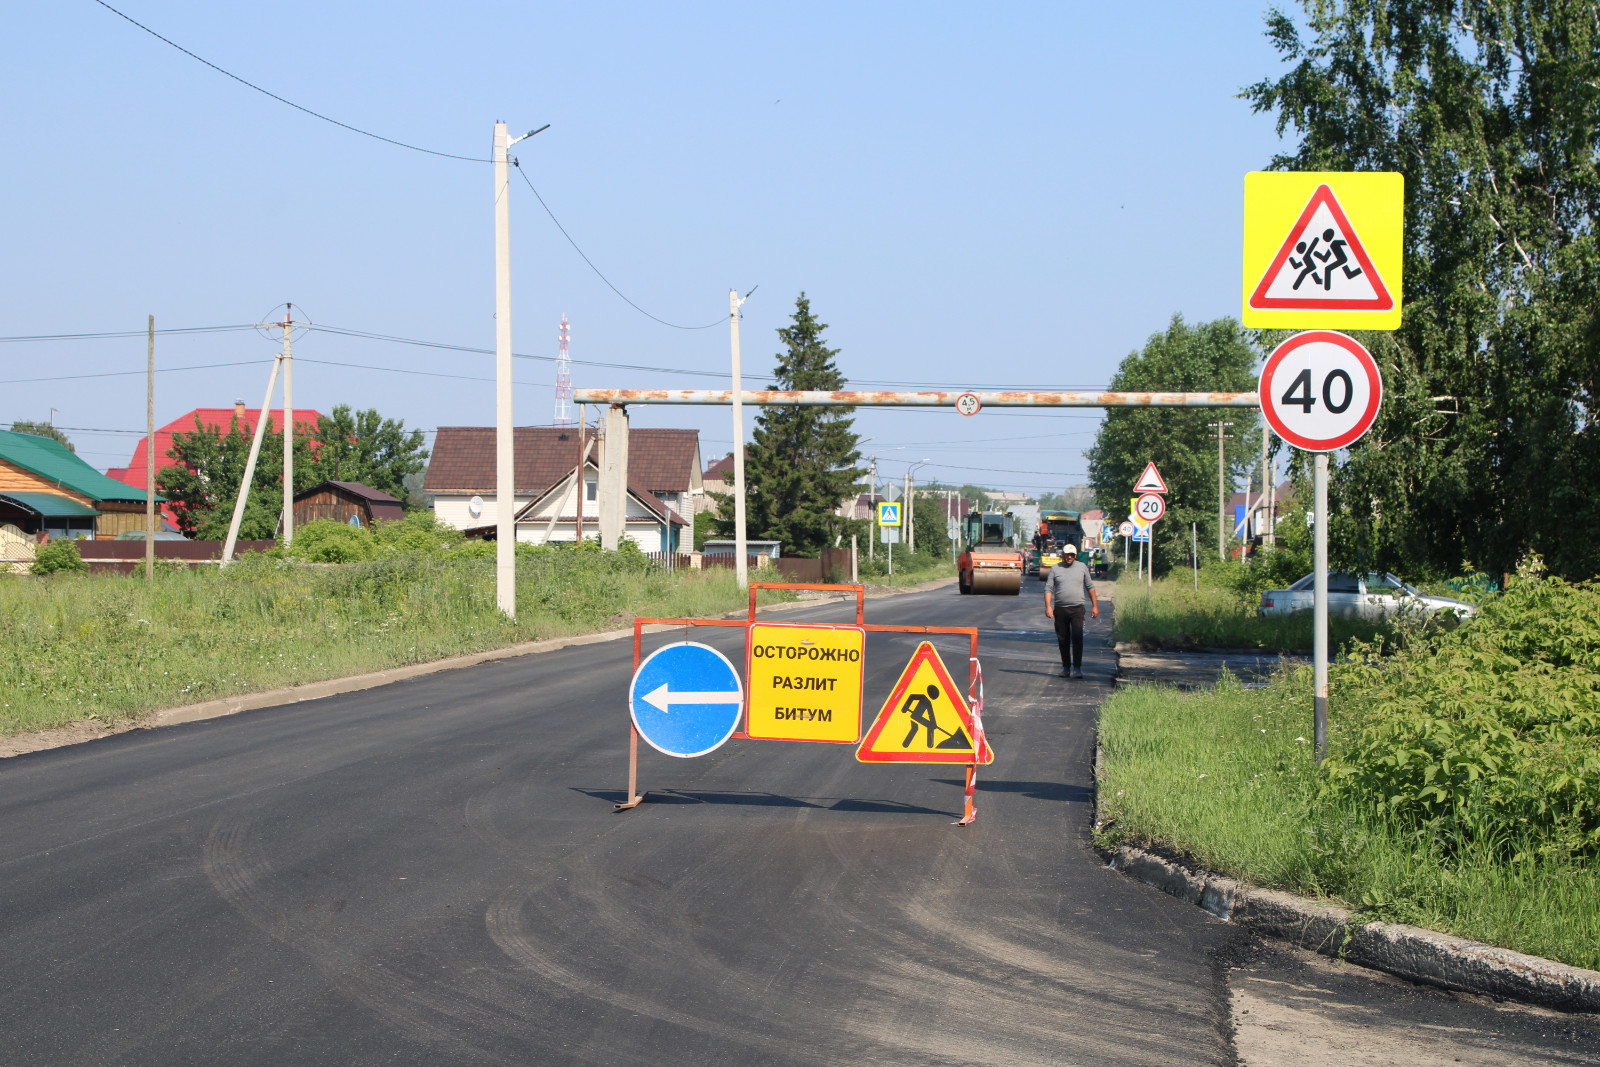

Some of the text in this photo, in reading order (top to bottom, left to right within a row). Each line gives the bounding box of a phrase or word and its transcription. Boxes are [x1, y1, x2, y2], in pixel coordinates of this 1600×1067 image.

[1281, 368, 1354, 414] 40
[1142, 501, 1158, 513] 20
[753, 645, 860, 662] ОСТОРОЖНО
[772, 675, 838, 691] РАЗЛИТ
[774, 707, 832, 722] БИТУМ
